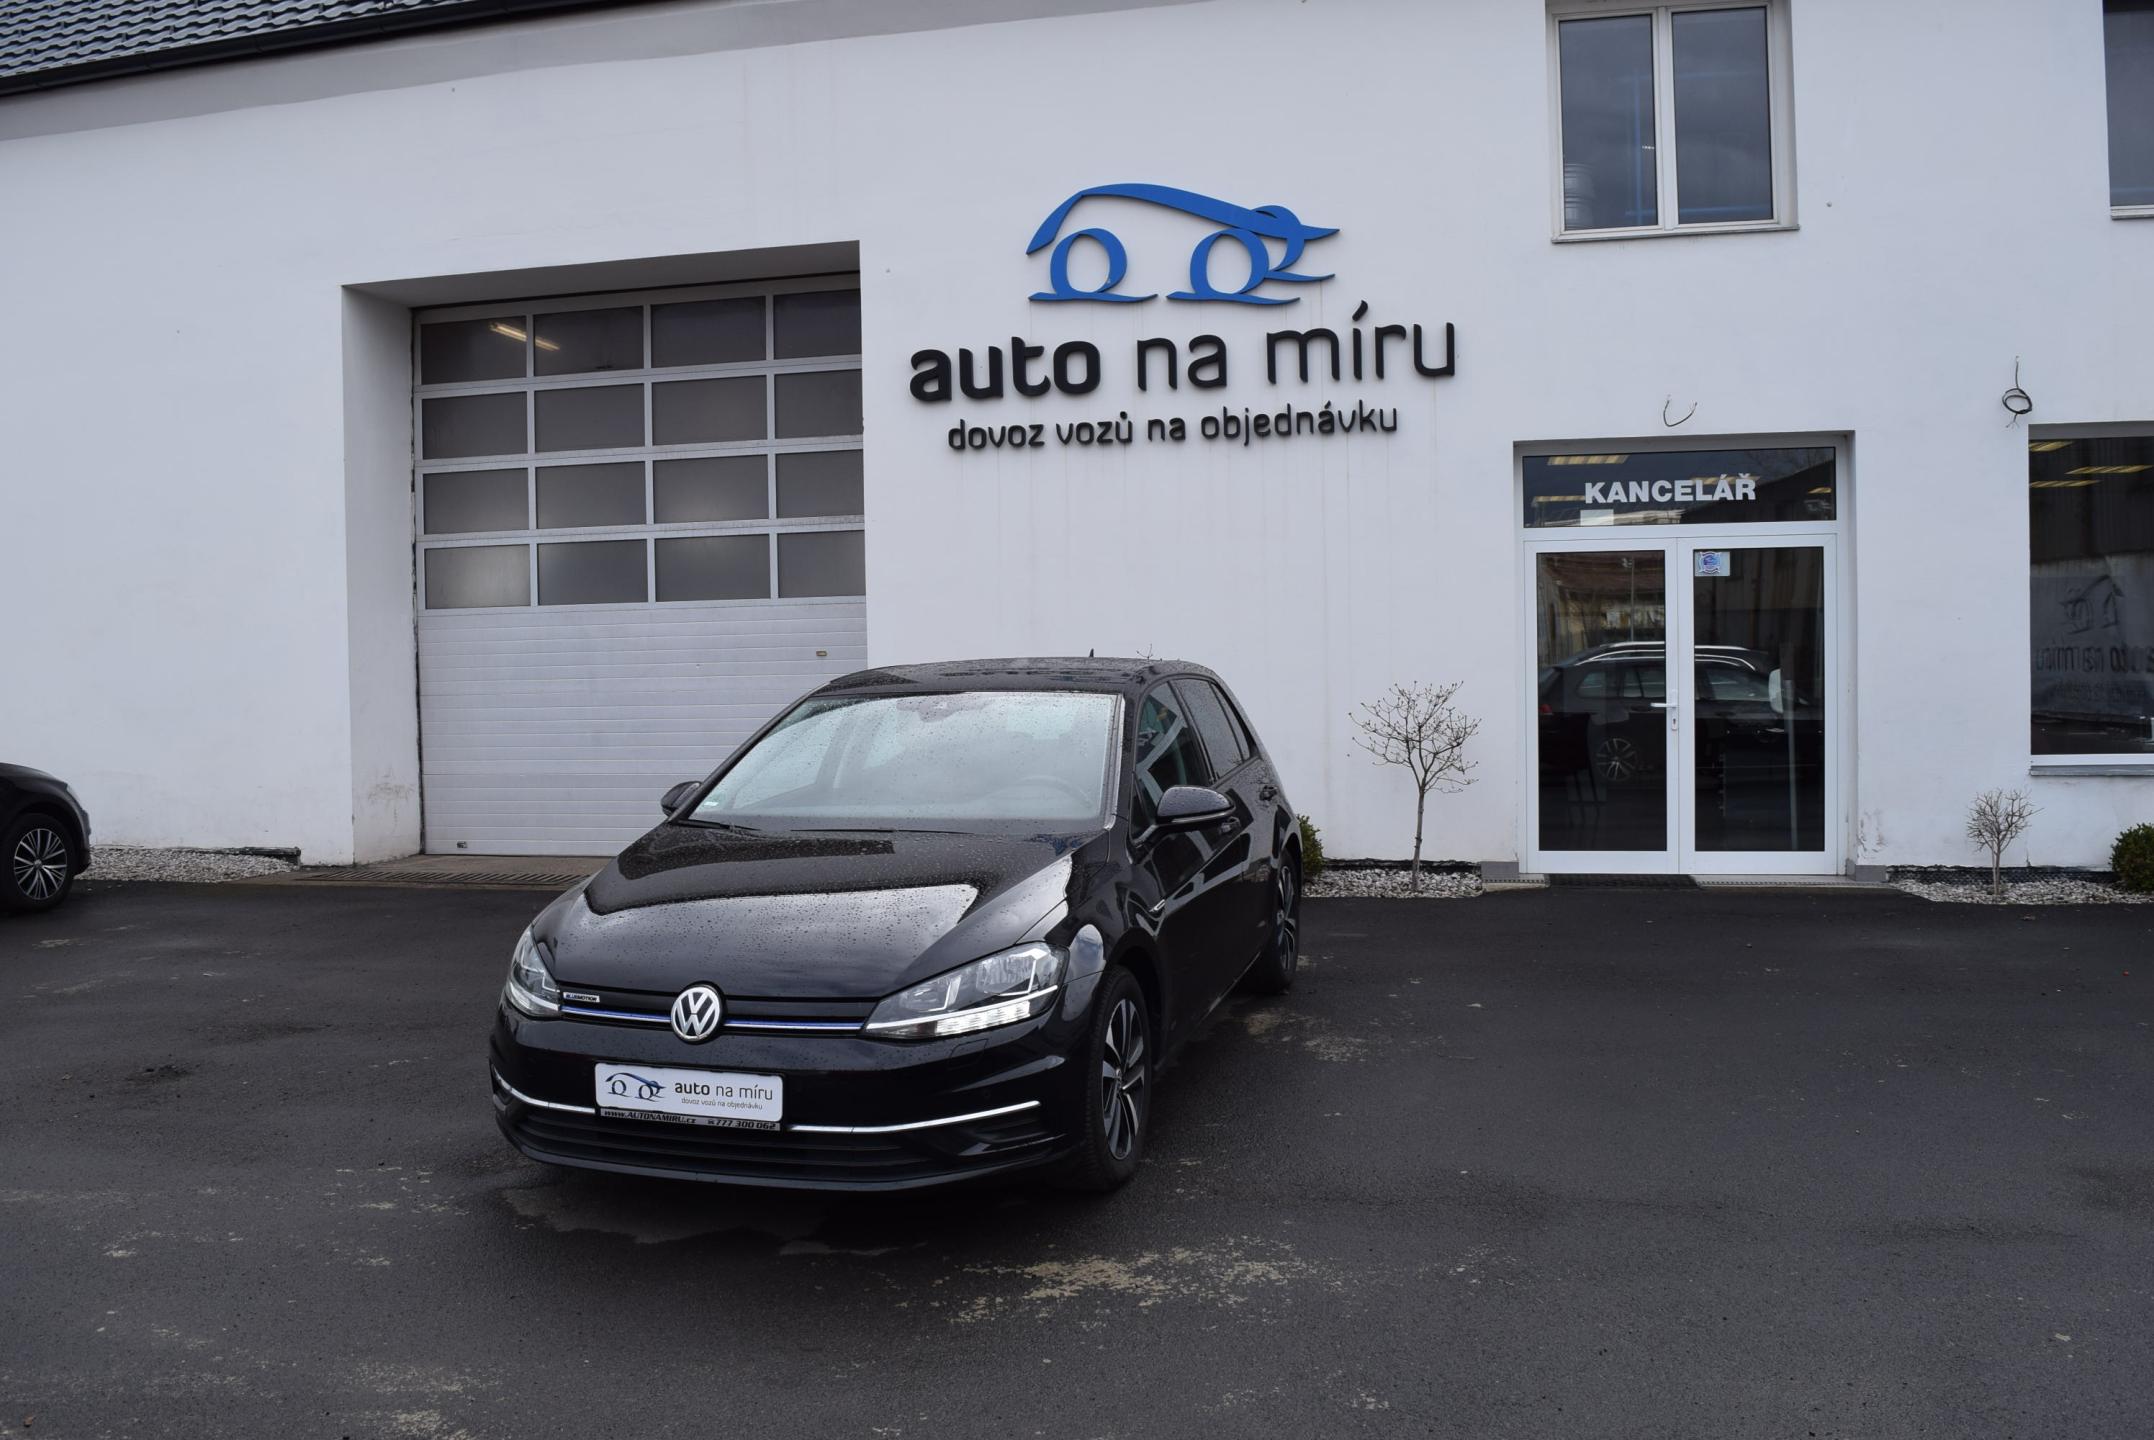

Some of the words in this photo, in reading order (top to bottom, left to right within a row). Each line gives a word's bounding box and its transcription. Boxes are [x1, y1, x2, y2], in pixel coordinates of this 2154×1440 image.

[909, 337, 1101, 405] auto
[1137, 334, 1228, 392] na
[1266, 300, 1456, 386] míru
[948, 418, 1045, 452] dovoz
[1056, 411, 1133, 447] vozů
[1148, 418, 1186, 443] na
[1201, 400, 1398, 447] objednávku
[1585, 473, 1756, 504] KANCELÁŘ
[674, 1082, 711, 1096] auto
[716, 1085, 733, 1098] na
[739, 1084, 773, 1100] míru
[681, 1097, 700, 1105] dovoz
[717, 1100, 726, 1108] na
[726, 1101, 763, 1111] objednávku
[716, 1118, 734, 1128] 777
[735, 1120, 755, 1130] 300
[756, 1121, 777, 1131] 062
